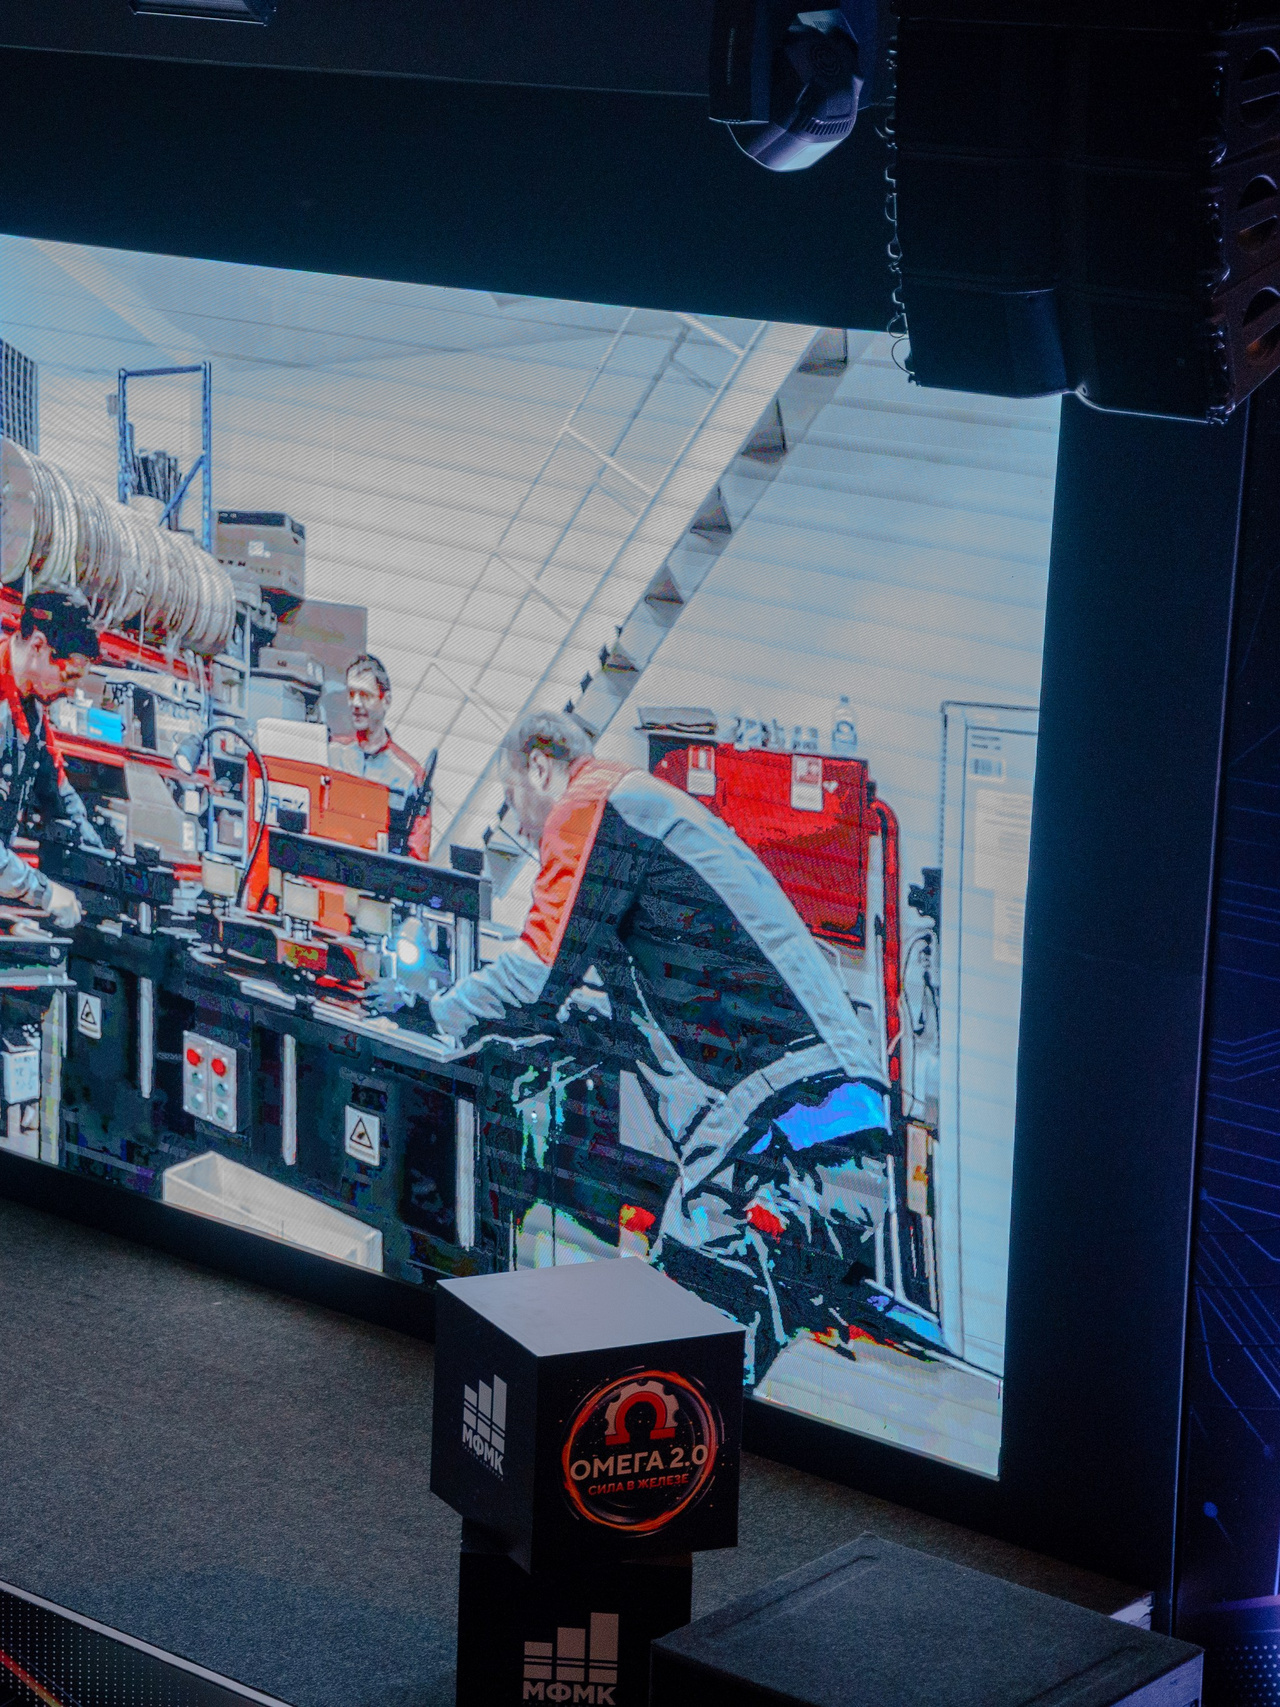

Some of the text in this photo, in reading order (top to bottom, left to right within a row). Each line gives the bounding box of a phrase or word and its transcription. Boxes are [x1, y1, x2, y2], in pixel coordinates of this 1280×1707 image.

[462, 1423, 504, 1476] МФМК
[570, 1444, 709, 1481] ОМЕГА 2.0
[587, 1473, 690, 1496] СИЛА В ЖЕЛЕЗЕ
[522, 1680, 617, 1706] МФМК
